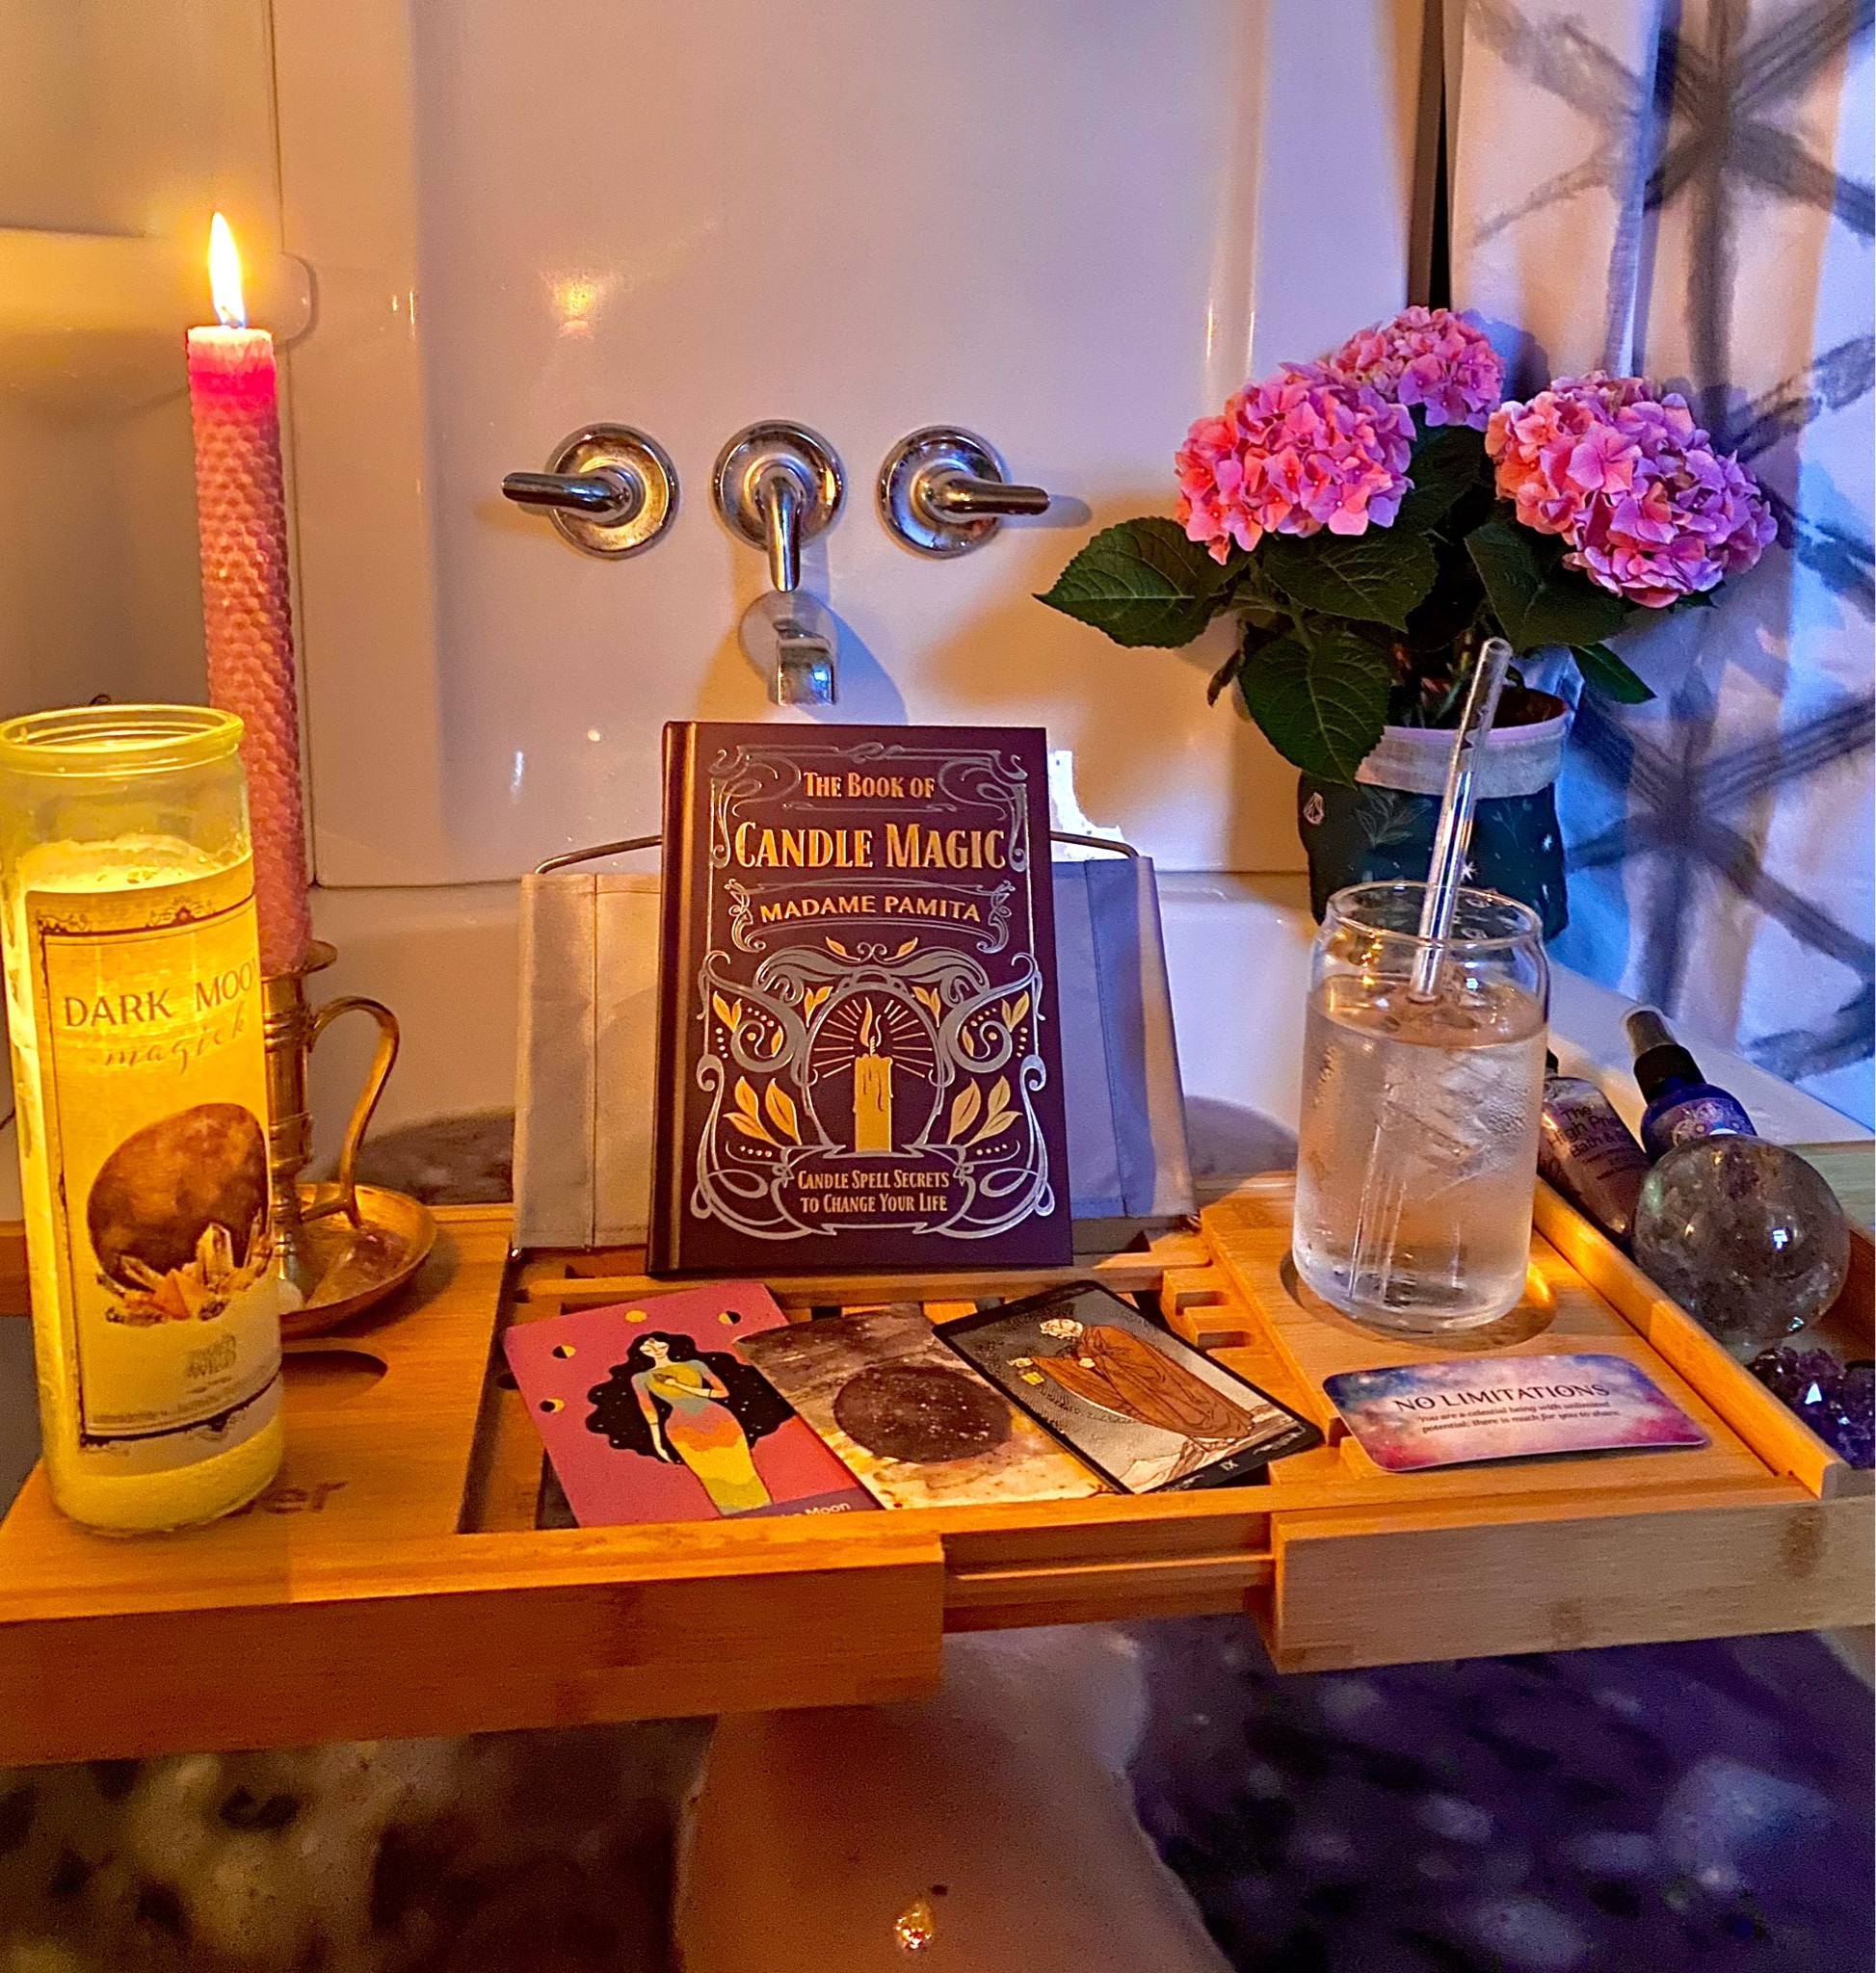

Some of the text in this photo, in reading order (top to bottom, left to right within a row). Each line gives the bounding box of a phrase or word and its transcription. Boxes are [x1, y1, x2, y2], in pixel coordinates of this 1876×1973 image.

[804, 771, 842, 798] THE
[847, 771, 904, 798] BOOK
[735, 821, 1006, 869] CANDLE MAGIC
[759, 895, 981, 923] MADAME PAMITA
[64, 987, 173, 1028] DARK
[103, 999, 246, 1077] magick
[1561, 1105, 1593, 1121] The
[1569, 1134, 1603, 1158] Bath
[797, 1169, 950, 1190] CANDLE SPELL SECRETS
[800, 1193, 948, 1214] TO CHANGE YOUR LIFE
[1393, 1383, 1611, 1412] NO LIMITATIONS
[1563, 1401, 1611, 1409] unlimited
[1541, 1412, 1555, 1422] for
[1558, 1412, 1578, 1421] you
[805, 1502, 851, 1516] Moon
